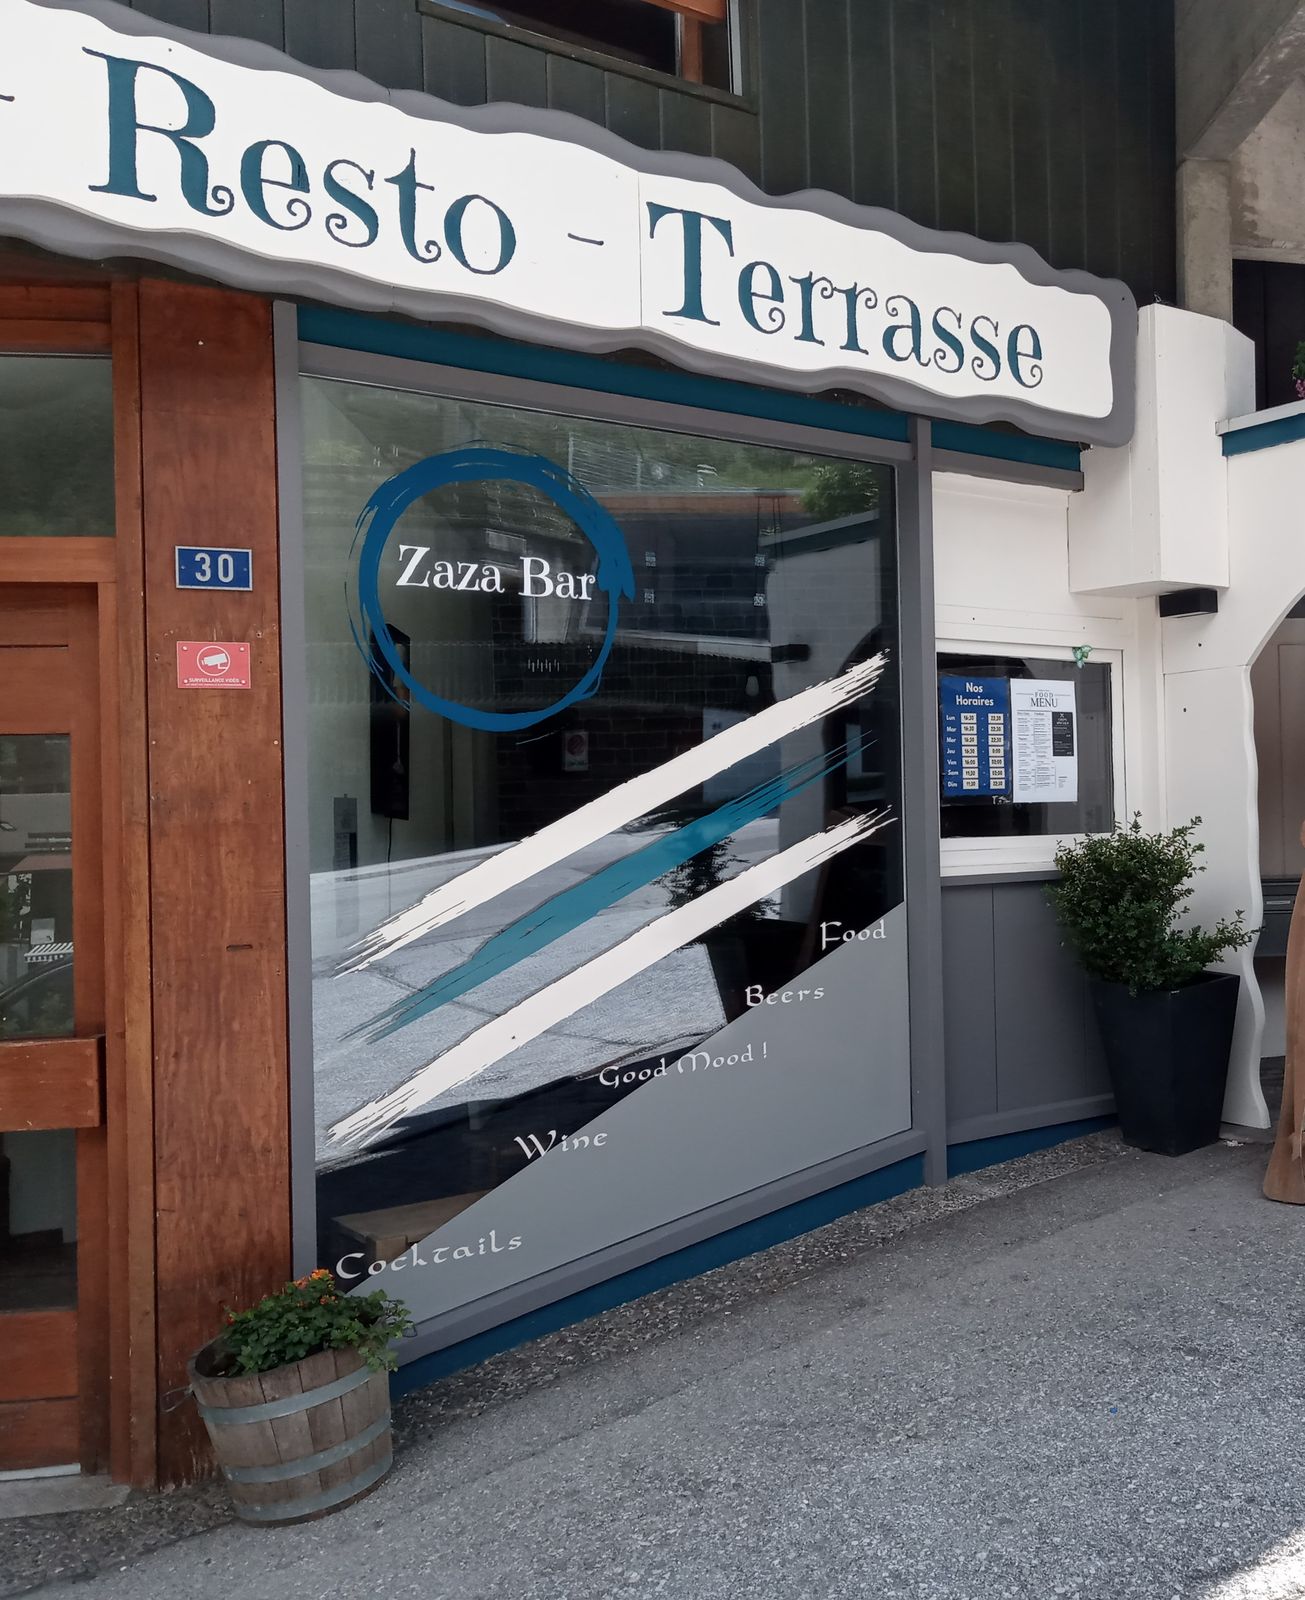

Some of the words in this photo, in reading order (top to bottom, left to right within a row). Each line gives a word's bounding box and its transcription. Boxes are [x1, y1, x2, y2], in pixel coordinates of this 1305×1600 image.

[82, 46, 517, 275] Resto
[646, 201, 1044, 389] Terrasse
[194, 552, 234, 583] 30
[396, 543, 505, 594] Zaza
[518, 556, 596, 602] Bar
[956, 695, 994, 706] Horaires
[966, 682, 984, 693] Nos
[1030, 697, 1058, 708] MENU
[820, 919, 887, 951] Food
[745, 984, 825, 1008] Beers
[599, 1057, 668, 1088] Good
[677, 1043, 754, 1074] Mood
[513, 1129, 608, 1160] Wine
[335, 1229, 523, 1280] Cocktails
